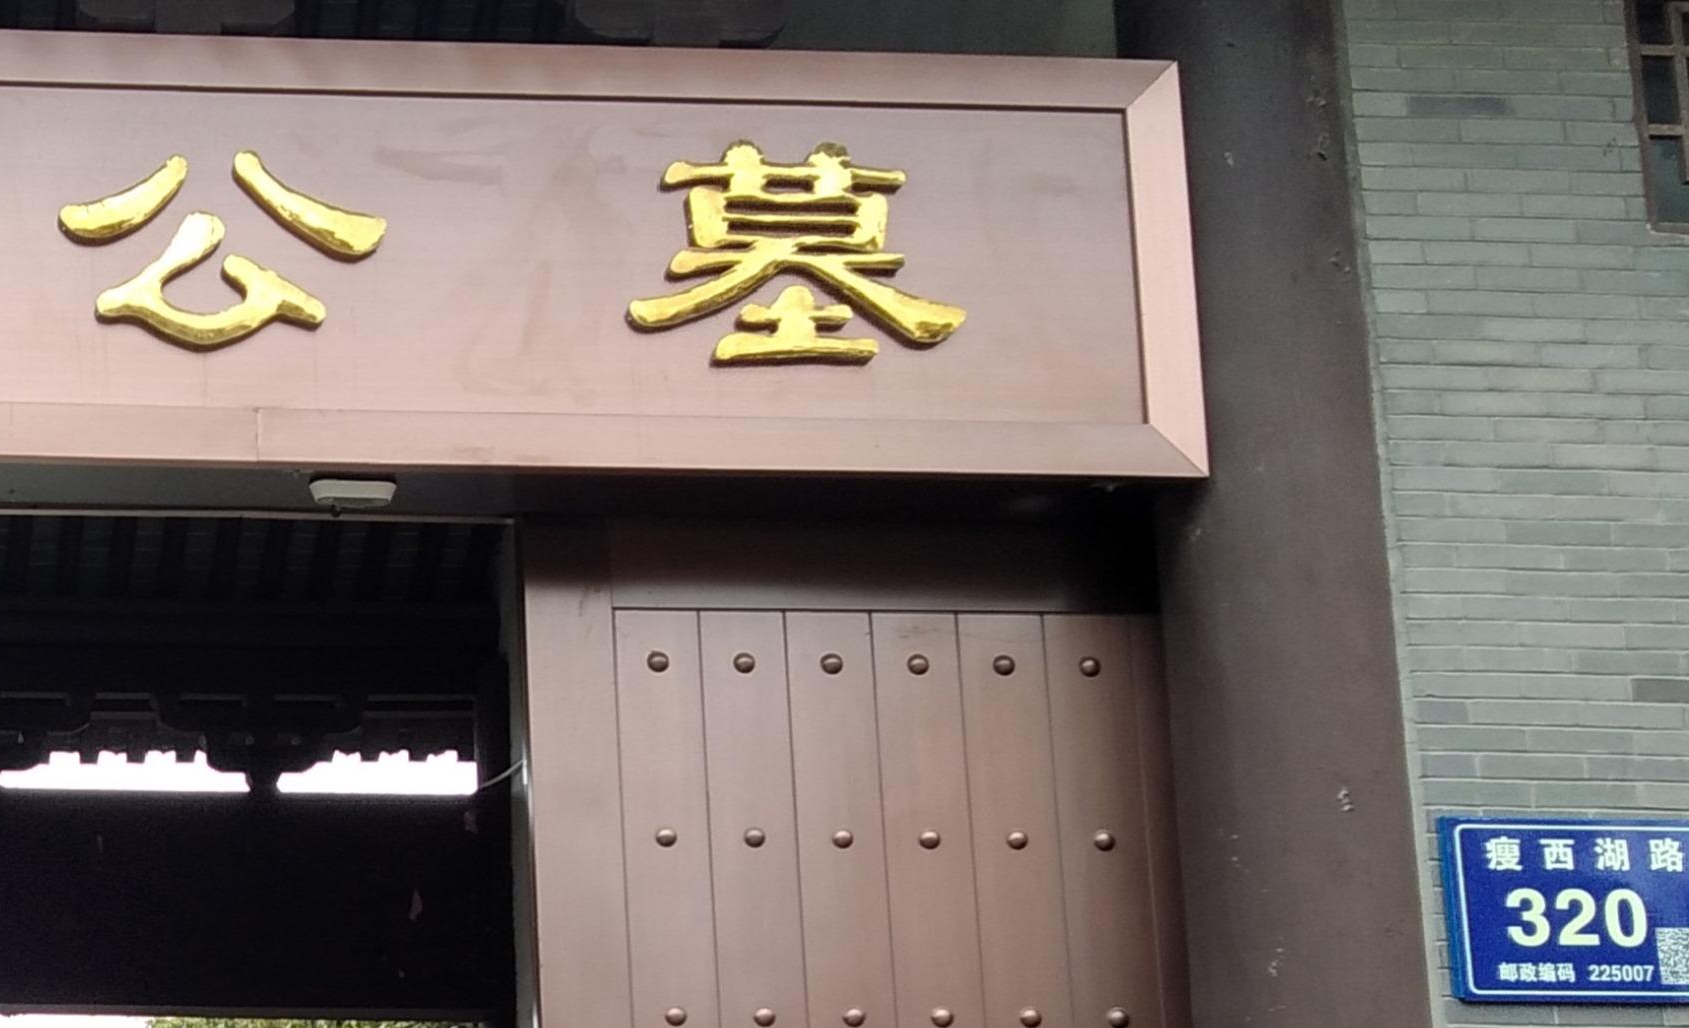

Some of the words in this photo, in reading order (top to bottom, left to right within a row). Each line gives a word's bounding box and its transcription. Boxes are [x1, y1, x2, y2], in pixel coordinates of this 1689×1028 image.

[1484, 836, 1684, 872] 瘦西湖路
[1505, 888, 1648, 947] 320
[1498, 962, 1576, 982] 邮政编码
[1588, 964, 1654, 982] 225007
